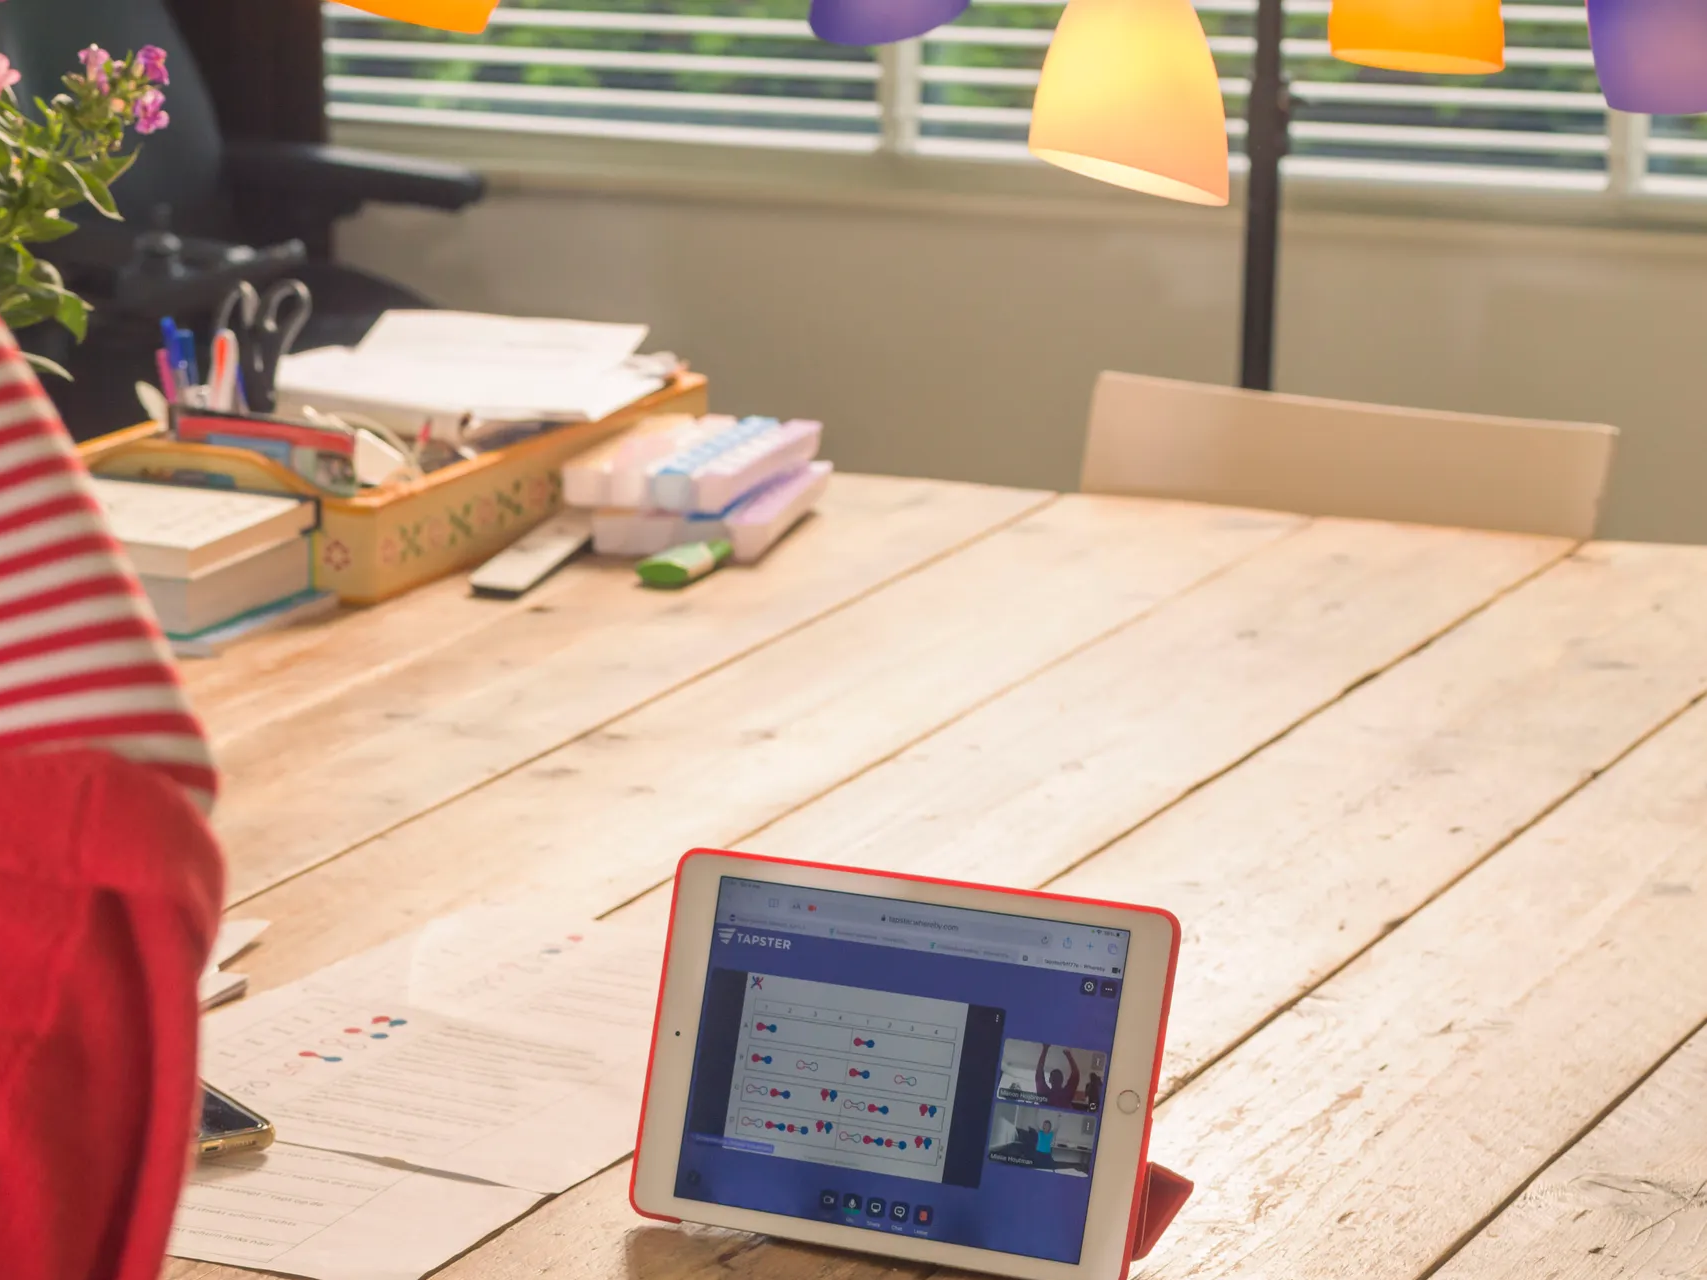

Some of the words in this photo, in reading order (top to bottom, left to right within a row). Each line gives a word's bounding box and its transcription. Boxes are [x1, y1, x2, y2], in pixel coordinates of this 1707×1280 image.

[888, 915, 959, 931] tapster.whereby.com
[737, 932, 792, 950] TAPSTER
[223, 1234, 249, 1242] links
